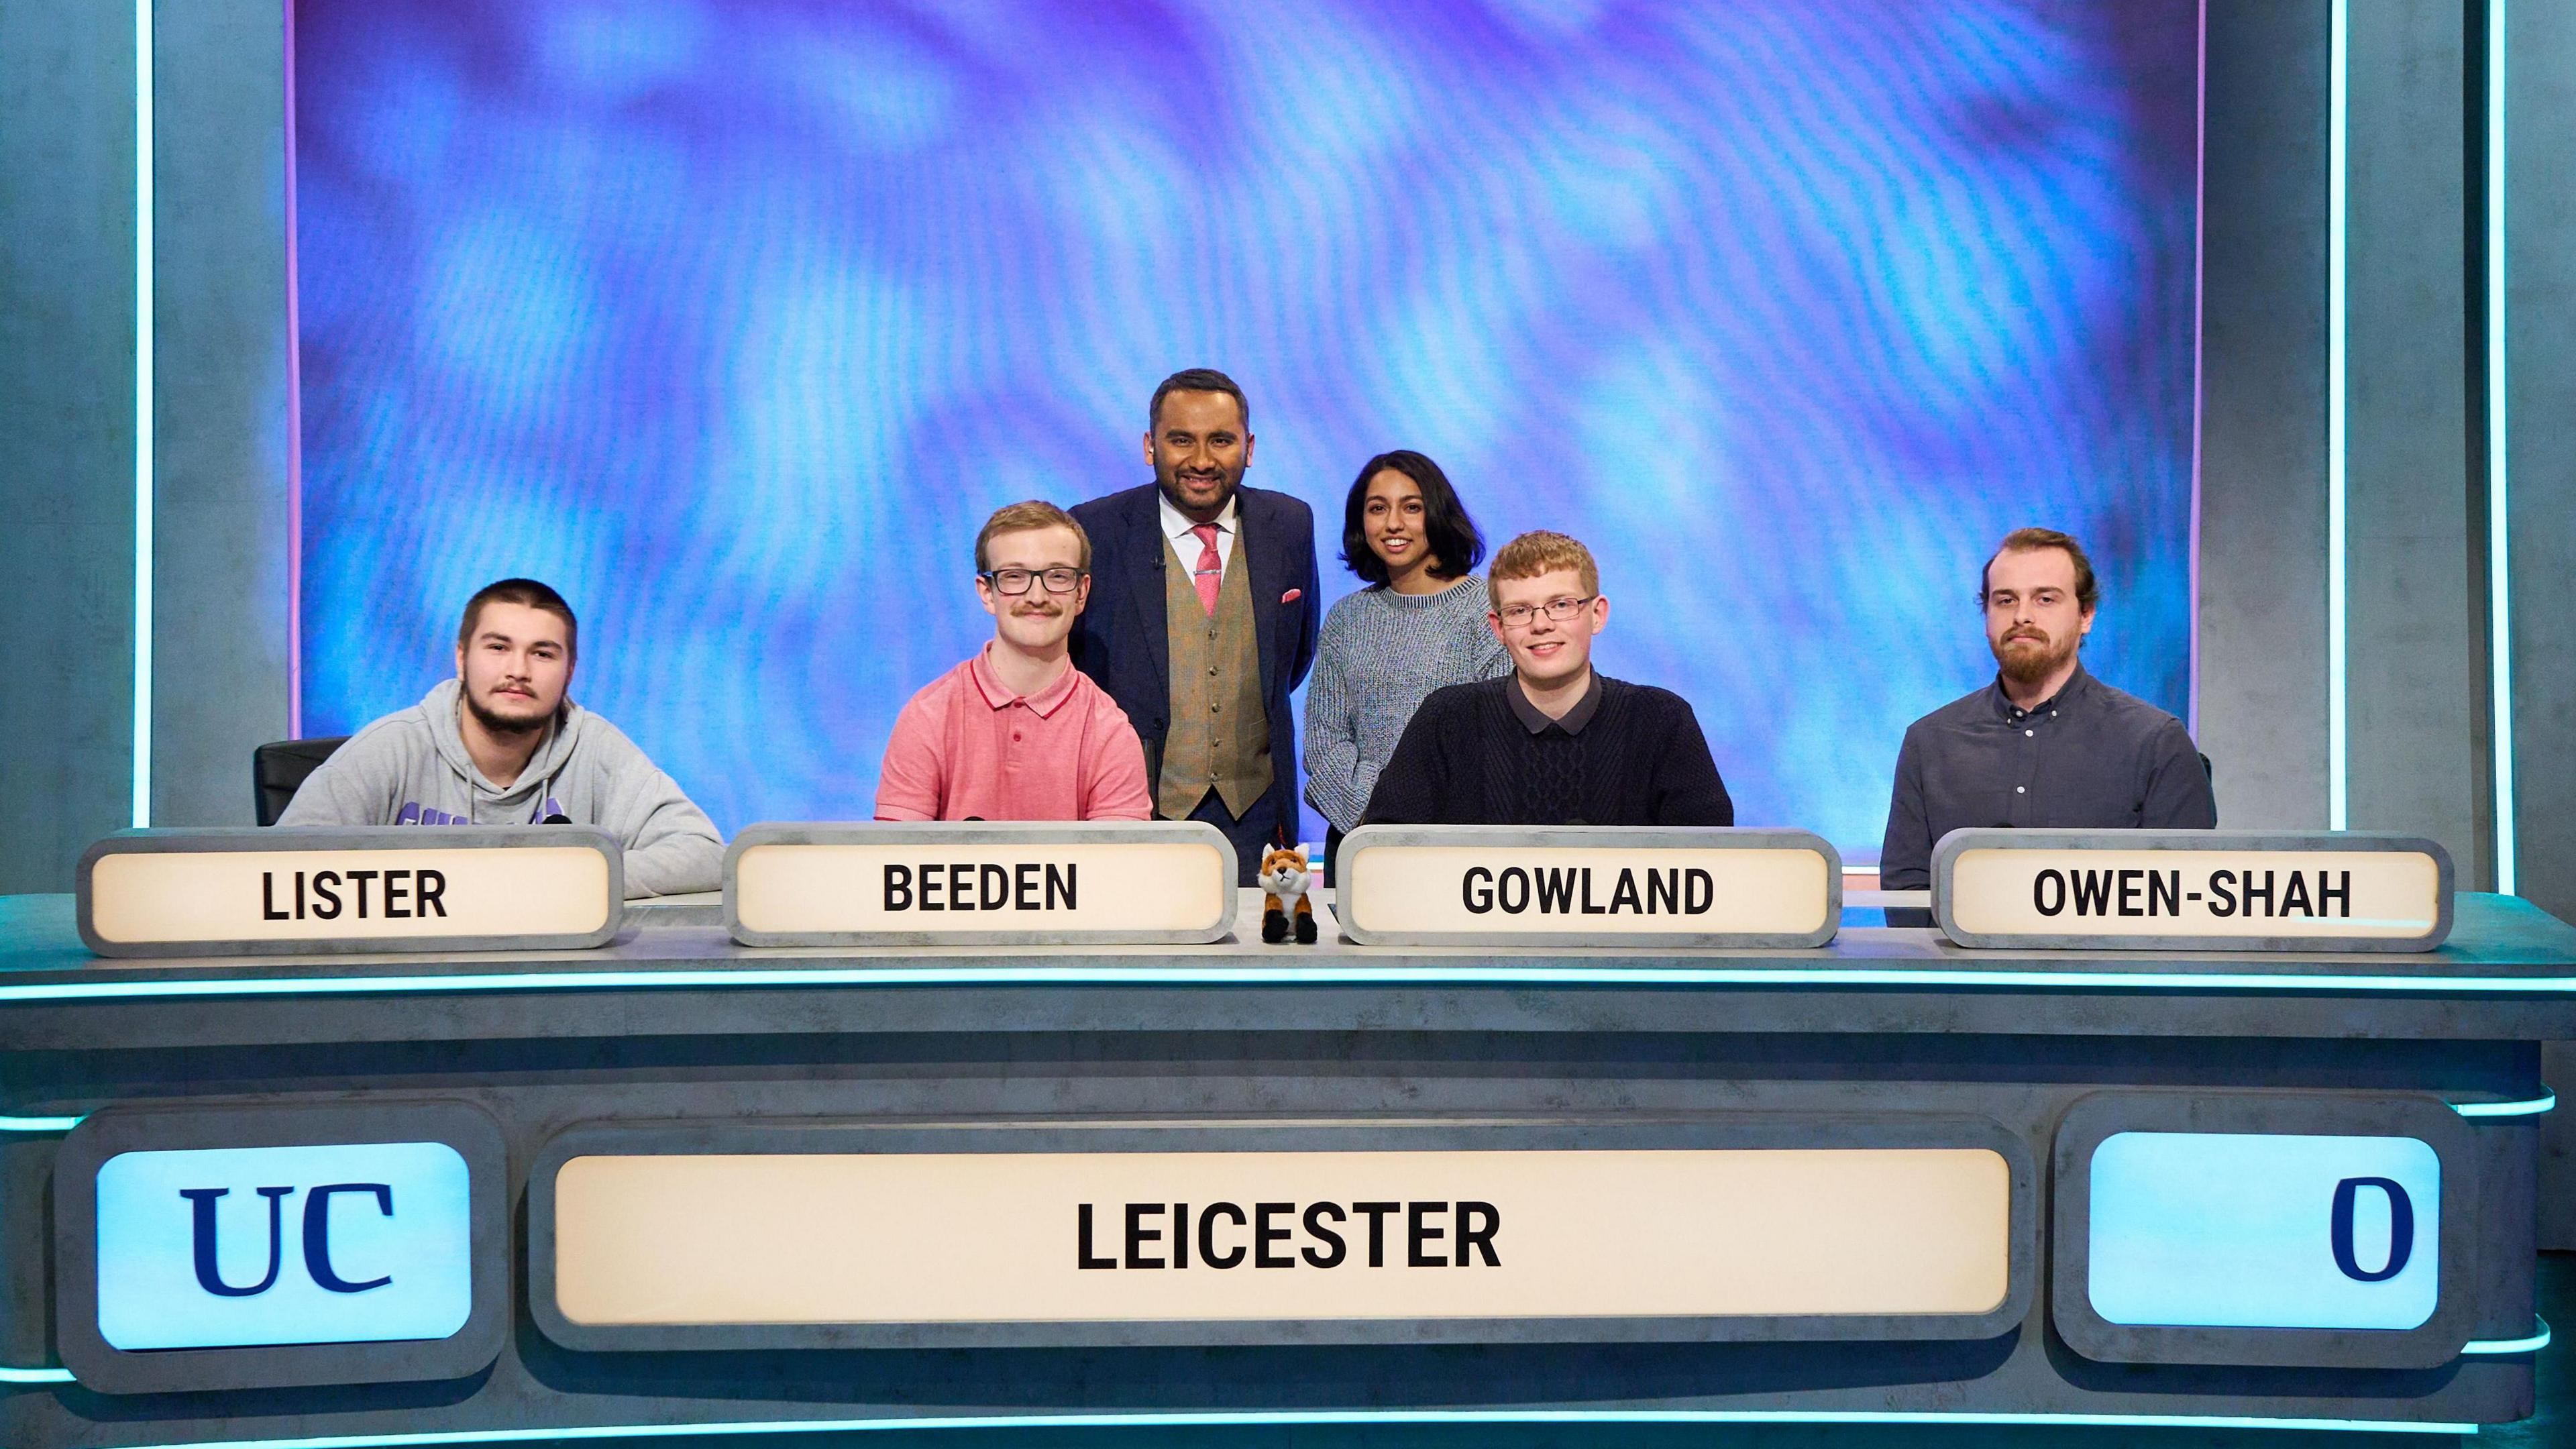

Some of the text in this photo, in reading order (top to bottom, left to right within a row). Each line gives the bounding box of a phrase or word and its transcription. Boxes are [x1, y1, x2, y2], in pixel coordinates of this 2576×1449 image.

[263, 869, 447, 920] LISTER
[883, 863, 1077, 912] BEEDEN
[1462, 866, 1713, 915] GOWLAND
[2033, 869, 2350, 918] OWEN-SHAH
[179, 1183, 393, 1297] UC
[1078, 1201, 1501, 1270] LEICESTER
[2331, 1177, 2414, 1282] 0
